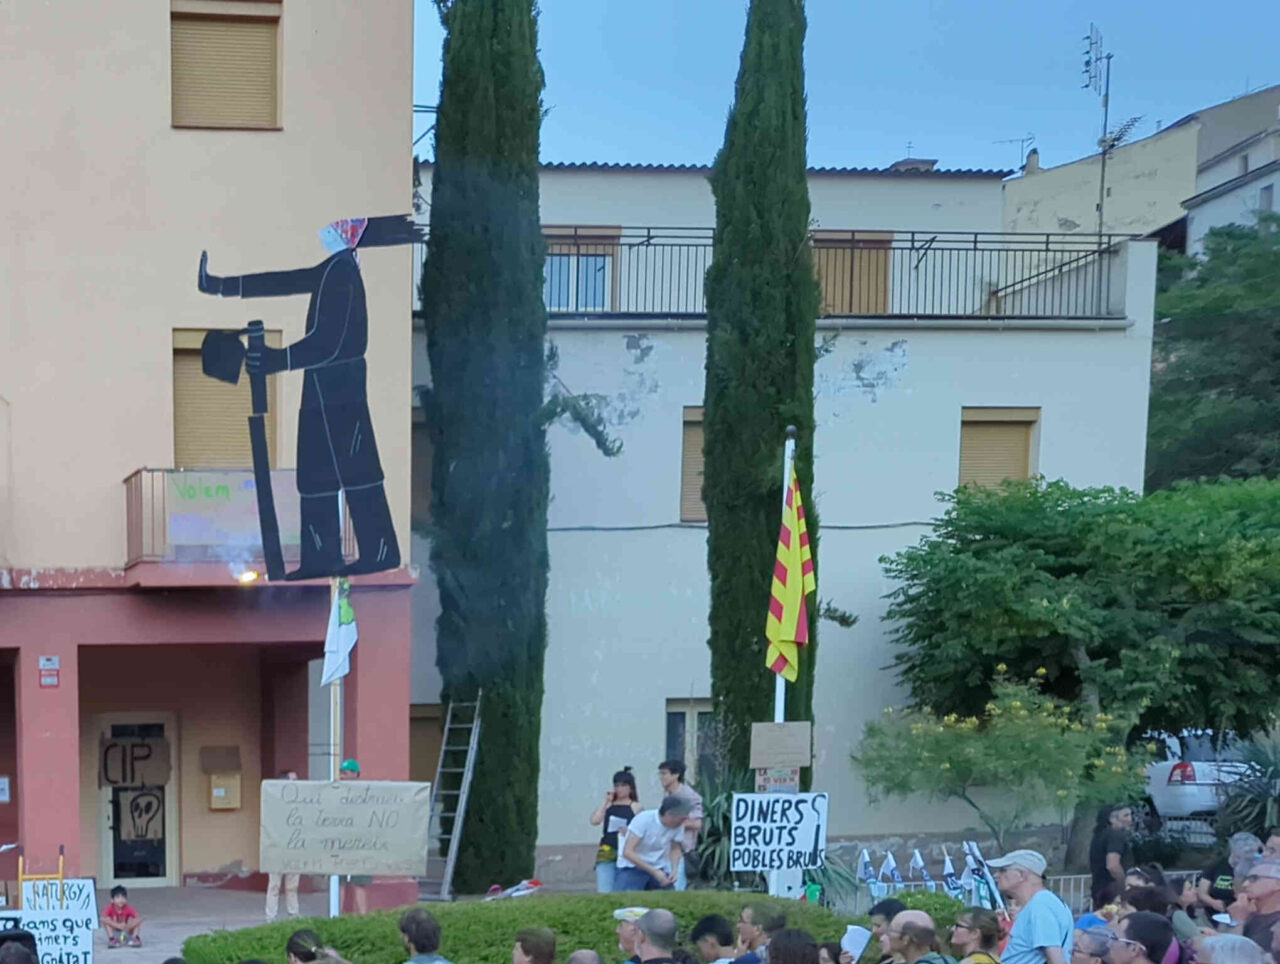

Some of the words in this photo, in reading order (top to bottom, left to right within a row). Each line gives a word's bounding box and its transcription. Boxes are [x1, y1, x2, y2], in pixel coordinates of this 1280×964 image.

[286, 807, 304, 828] la
[315, 809, 355, 828] terra
[368, 809, 400, 829] NO
[735, 798, 808, 825] DINERS
[287, 829, 306, 850] la
[734, 825, 798, 847] BRUTS
[732, 848, 784, 870] POBLES
[62, 917, 92, 935] que
[38, 933, 79, 946] iners
